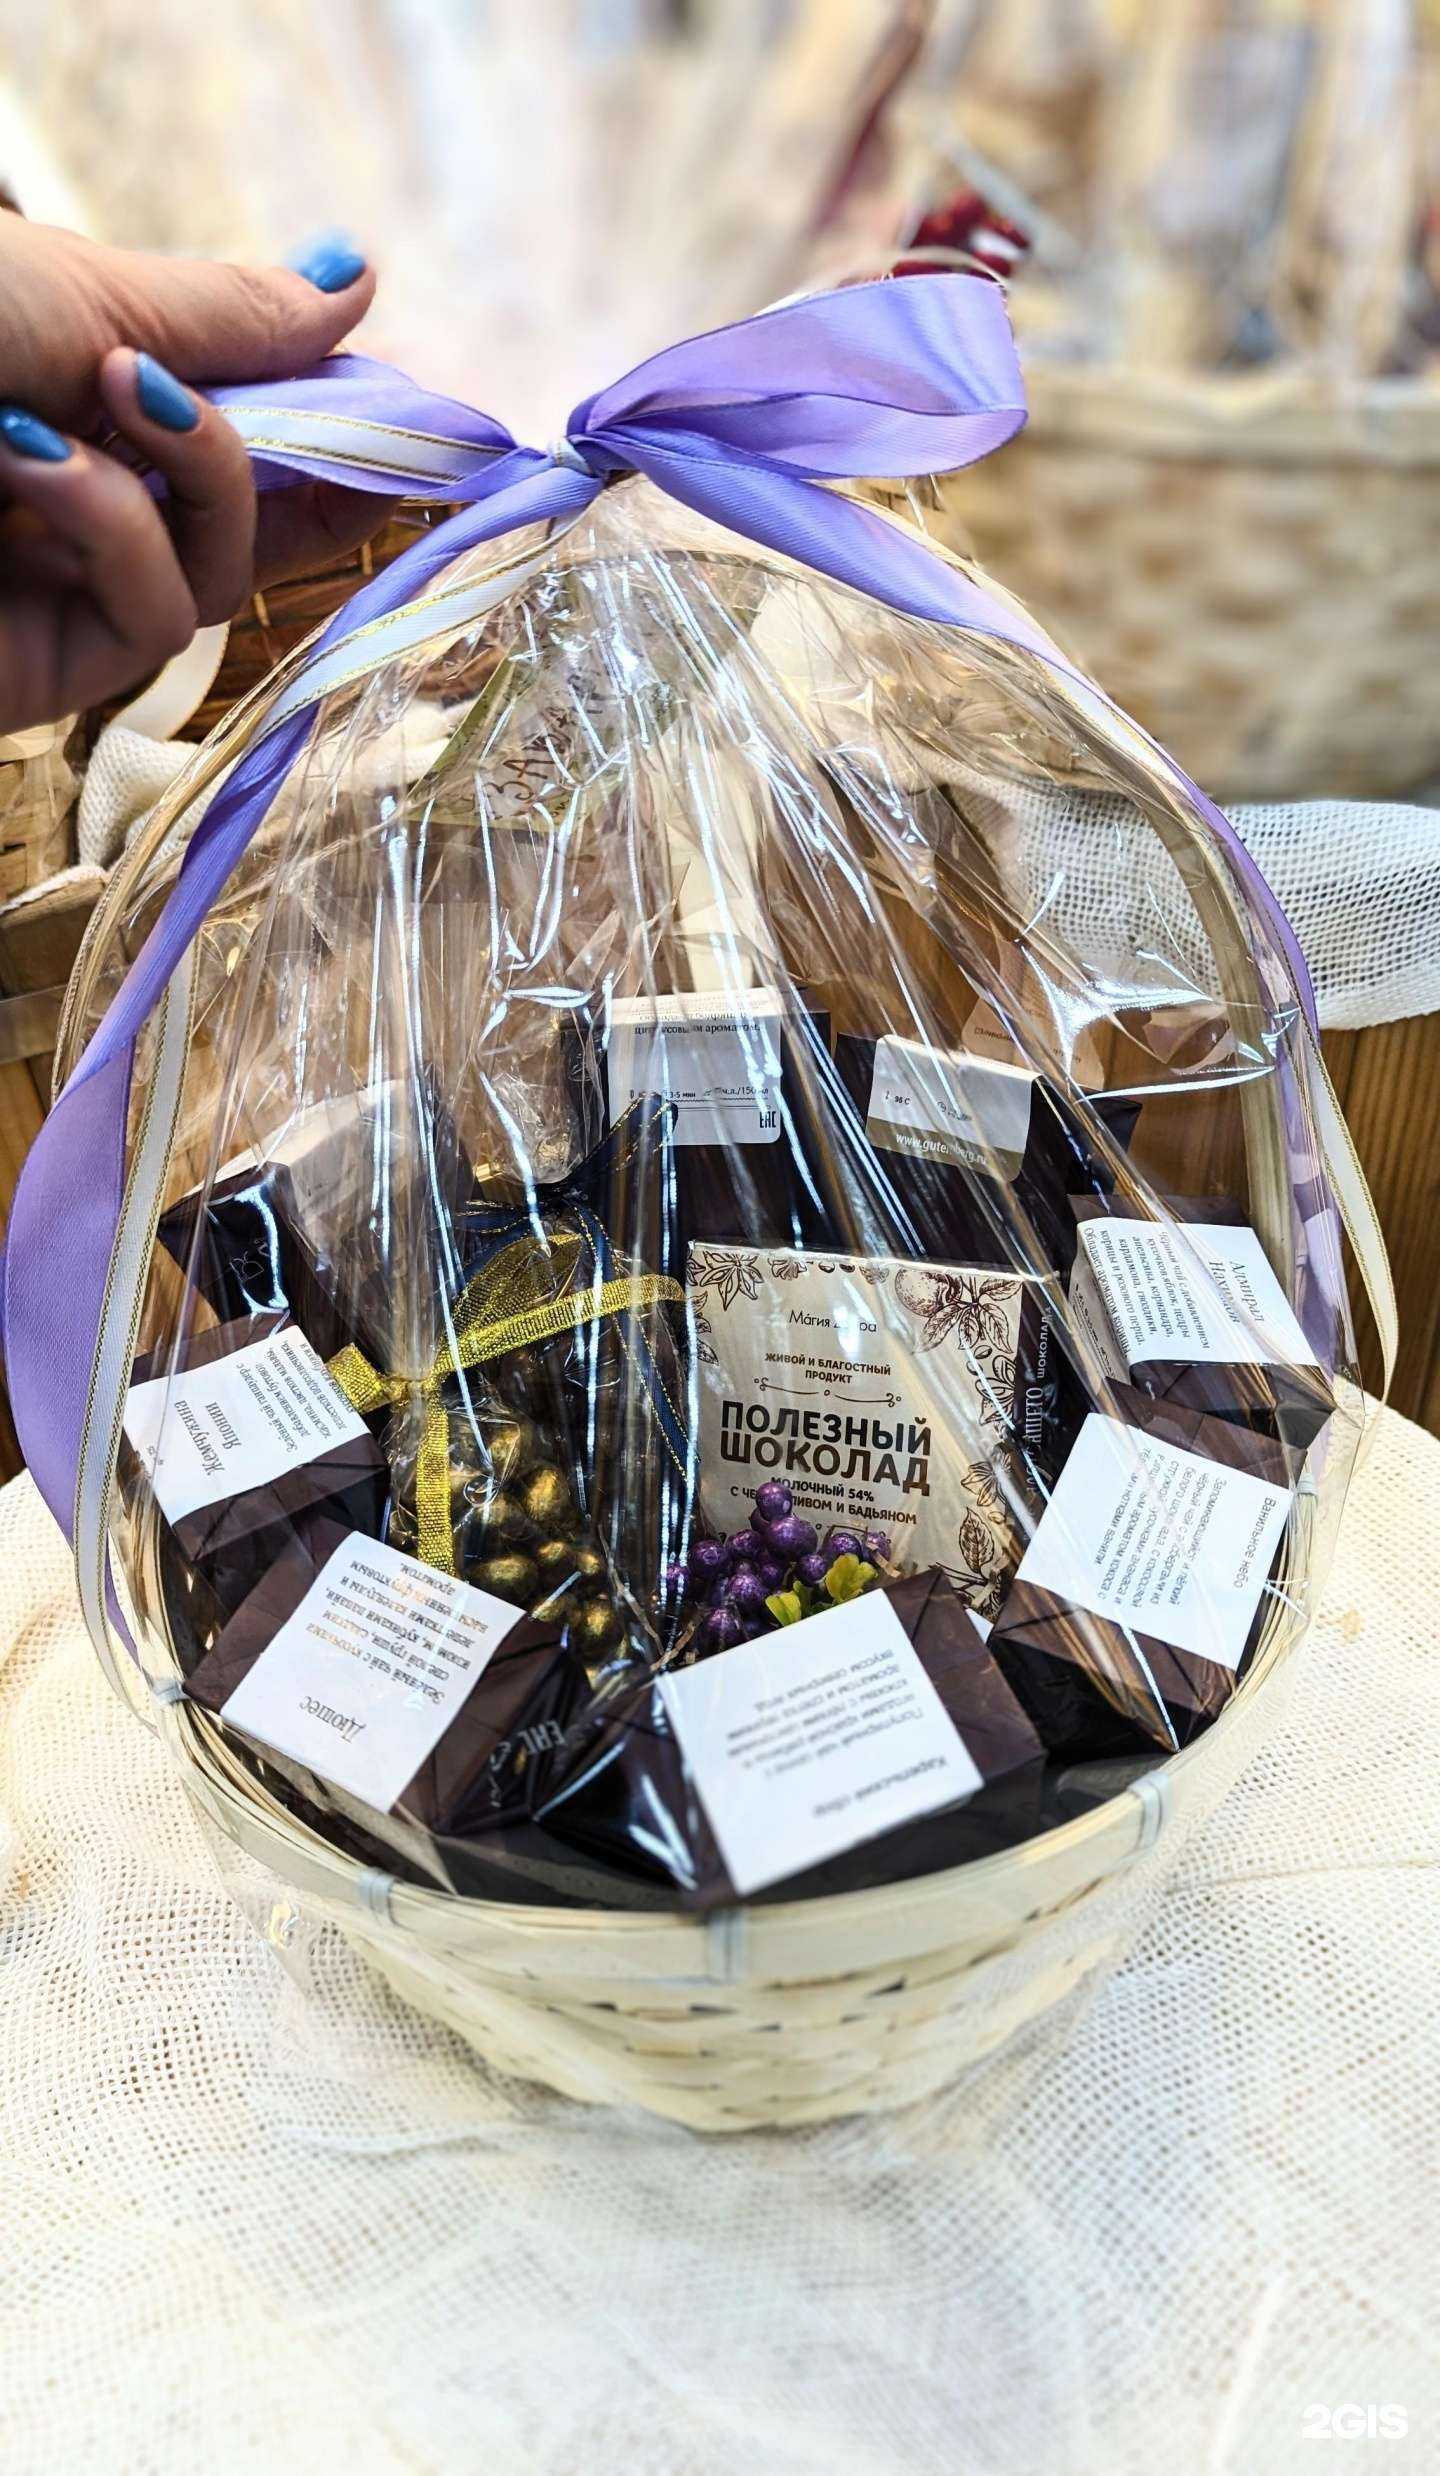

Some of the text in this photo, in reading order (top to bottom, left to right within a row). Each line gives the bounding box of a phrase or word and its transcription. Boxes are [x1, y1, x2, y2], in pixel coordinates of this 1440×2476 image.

[1083, 1226, 1104, 1269] Обладает
[1096, 1269, 1118, 1315] ароматом
[1097, 1231, 1118, 1263] корицы
[1112, 1274, 1135, 1313] розового
[1127, 1315, 1146, 1344] перца.
[1116, 1239, 1142, 1287] кардамона,
[1131, 1237, 1175, 1335] апельсина, кориандра,
[1229, 1262, 1265, 1321] Адмирал
[765, 1352, 891, 1375] ЖИВОЙ И БЛАГОСТНЫЙ
[805, 1370, 853, 1384] ПРОДУКТ
[172, 1398, 225, 1476] Жемчужина
[203, 1401, 241, 1451] Японии
[268, 1418, 297, 1452] Зелёный
[721, 1399, 932, 1456] ПОЛЕЗНЫЙ
[719, 1430, 931, 1497] ШОКОЛАД
[1175, 1466, 1196, 1499] белого
[730, 1486, 917, 1524] С ЧЕЛИВОМ И БАДЬЯНОМ
[849, 1489, 874, 1501] 54%
[1115, 1508, 1141, 1557] ароматом
[1232, 1496, 1276, 1590] Ванильное небо
[1117, 1553, 1140, 1595] ананаса
[295, 1694, 366, 1744] Дюшес
[852, 1753, 947, 1802] Карельский
